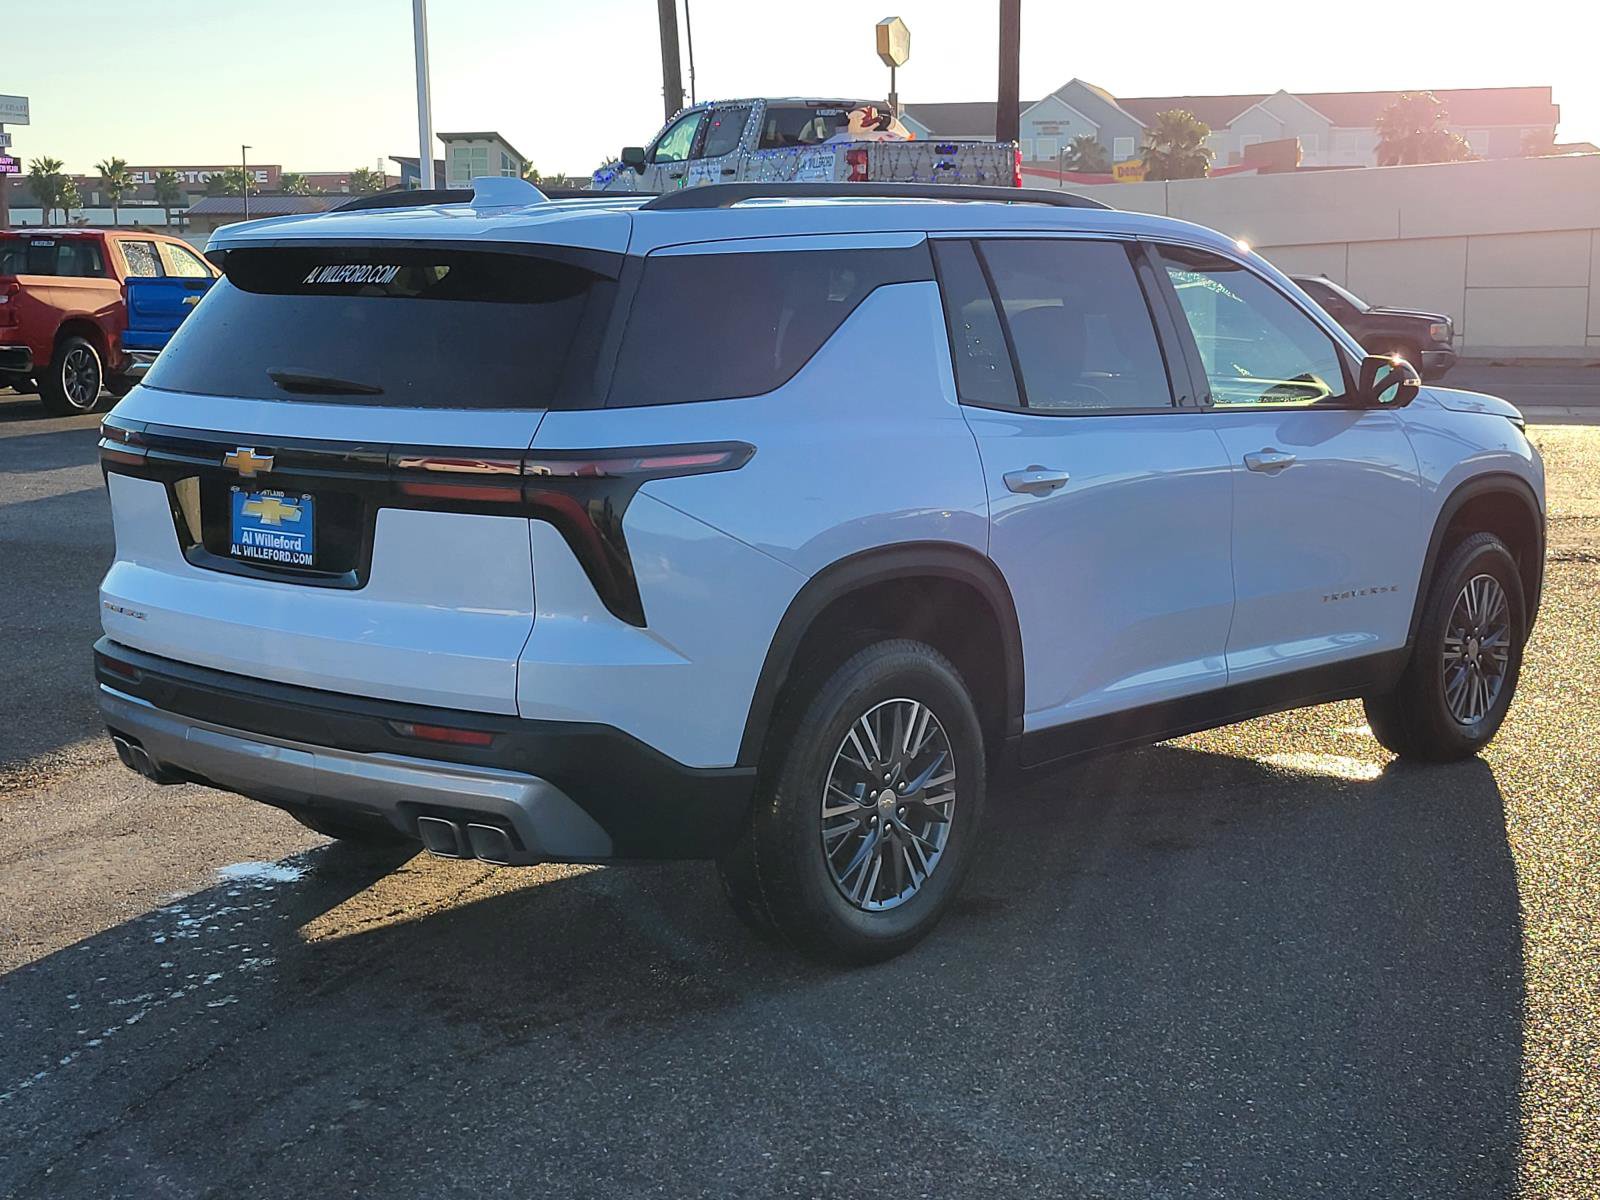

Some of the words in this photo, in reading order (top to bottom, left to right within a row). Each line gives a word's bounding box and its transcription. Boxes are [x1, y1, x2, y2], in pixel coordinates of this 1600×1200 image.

[302, 266, 323, 284] AL
[316, 264, 401, 284] WILLEFORD.COM
[242, 531, 253, 545] Al
[254, 532, 302, 552] Willeford
[230, 544, 241, 555] AL
[243, 545, 313, 566] WILLEFORD.COM
